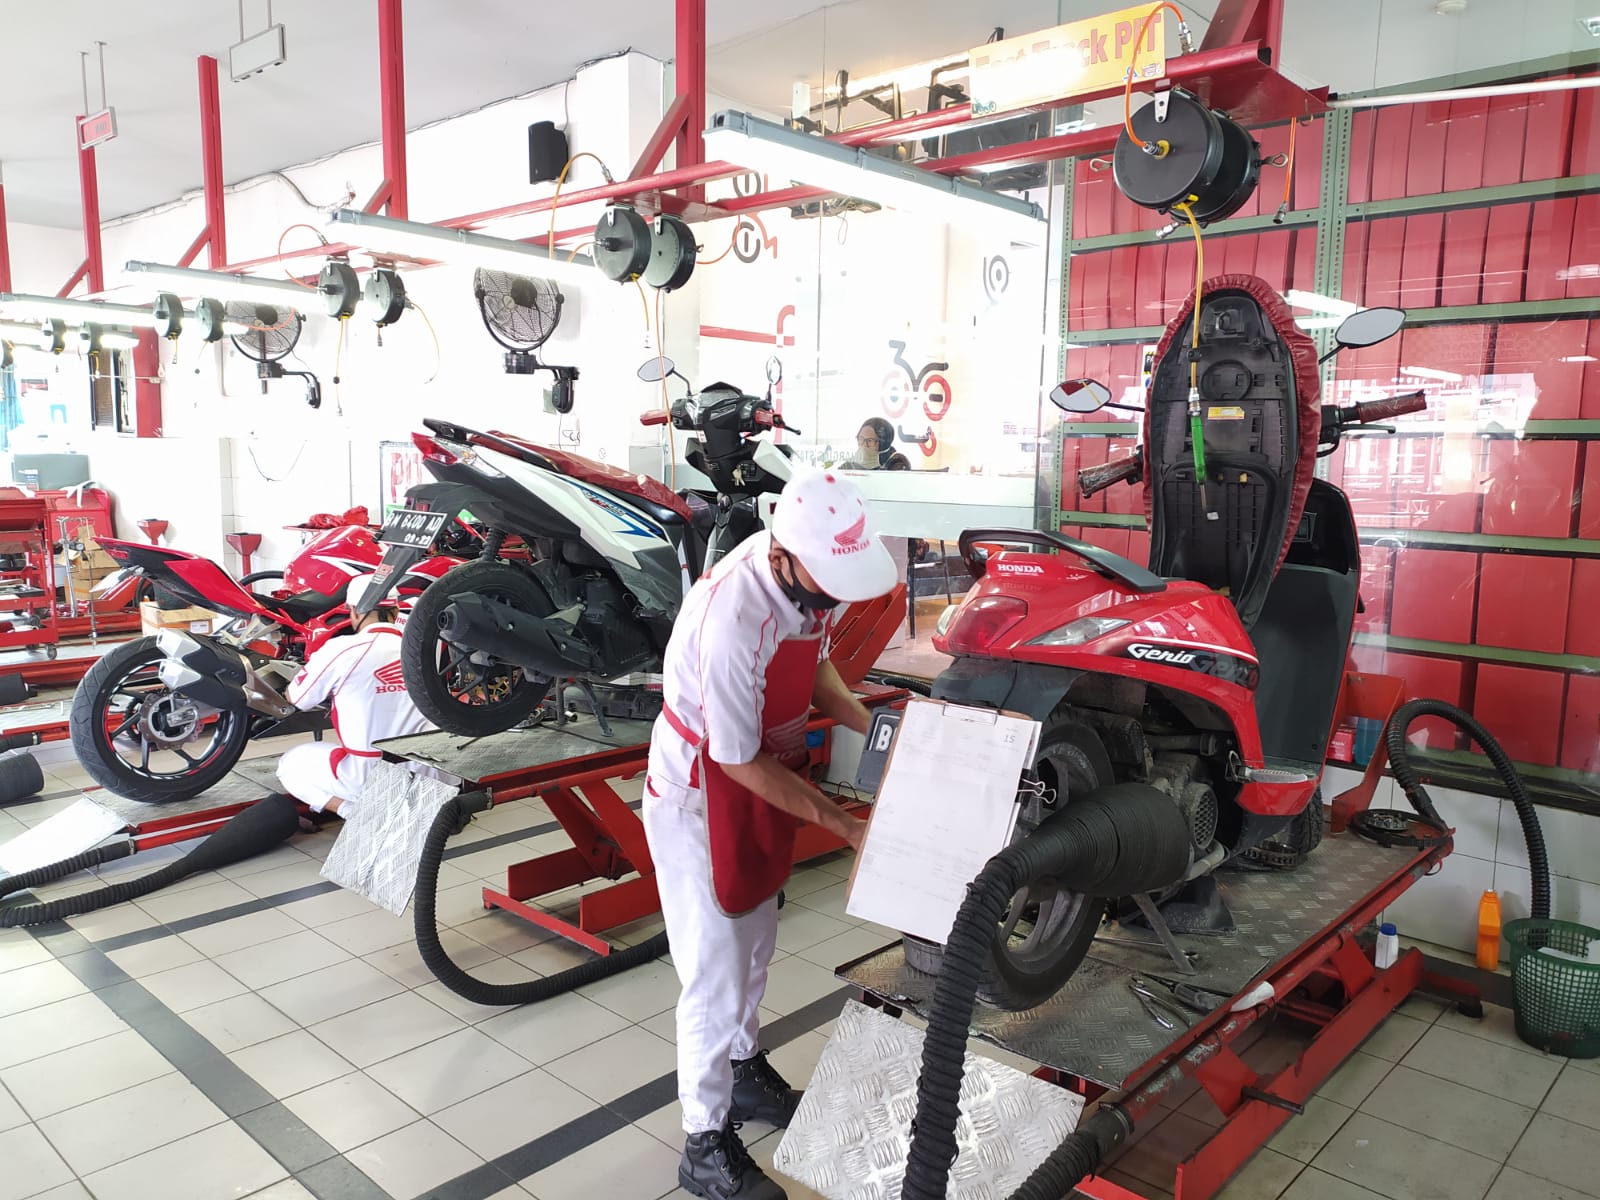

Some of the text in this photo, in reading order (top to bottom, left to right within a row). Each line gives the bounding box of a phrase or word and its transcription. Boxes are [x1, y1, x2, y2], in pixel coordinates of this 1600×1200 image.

[1115, 13, 1161, 59] PIT
[401, 513, 427, 530] 6400
[997, 563, 1044, 573] HONDA
[1127, 643, 1197, 664] Genio
[376, 685, 407, 694] HON
